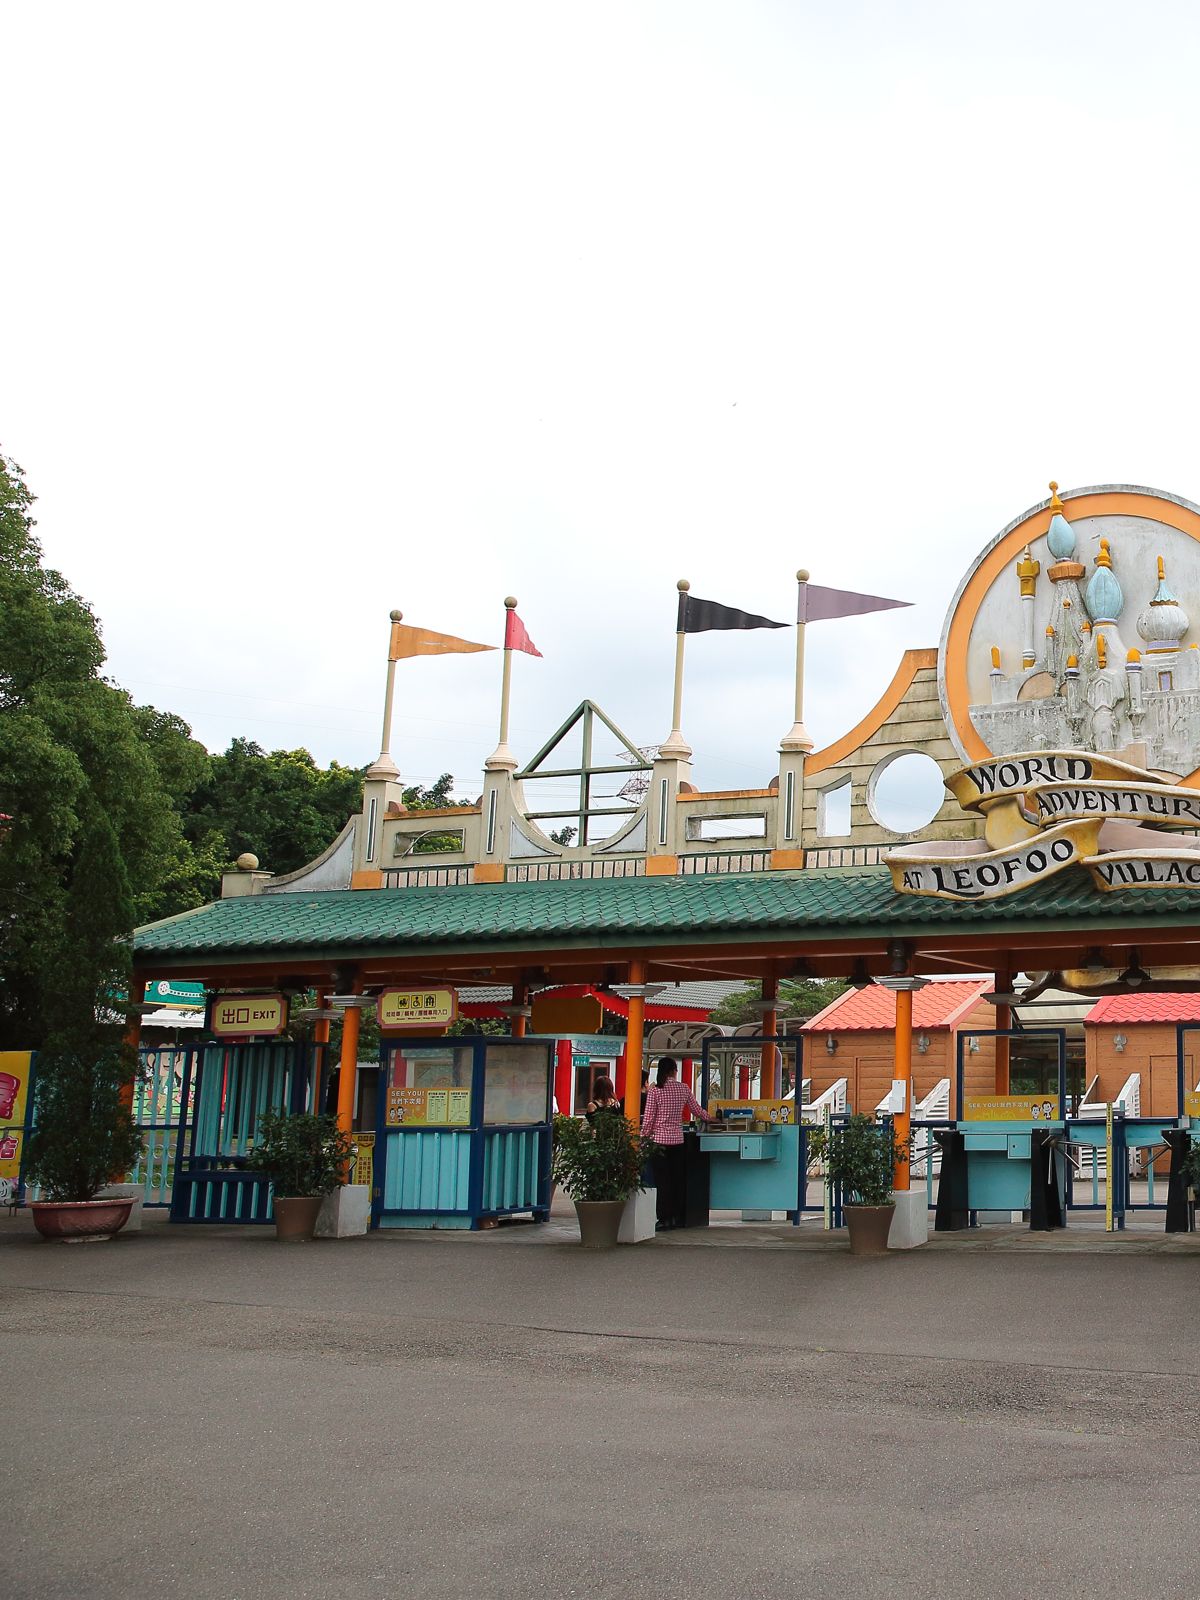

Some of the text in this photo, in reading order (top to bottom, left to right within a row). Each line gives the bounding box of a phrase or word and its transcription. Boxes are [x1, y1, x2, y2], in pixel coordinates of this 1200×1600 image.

[965, 757, 1093, 794] WORLD
[902, 871, 923, 889] AT
[931, 839, 1073, 898] LEOFOO
[222, 1008, 276, 1024] 出口 EXIT
